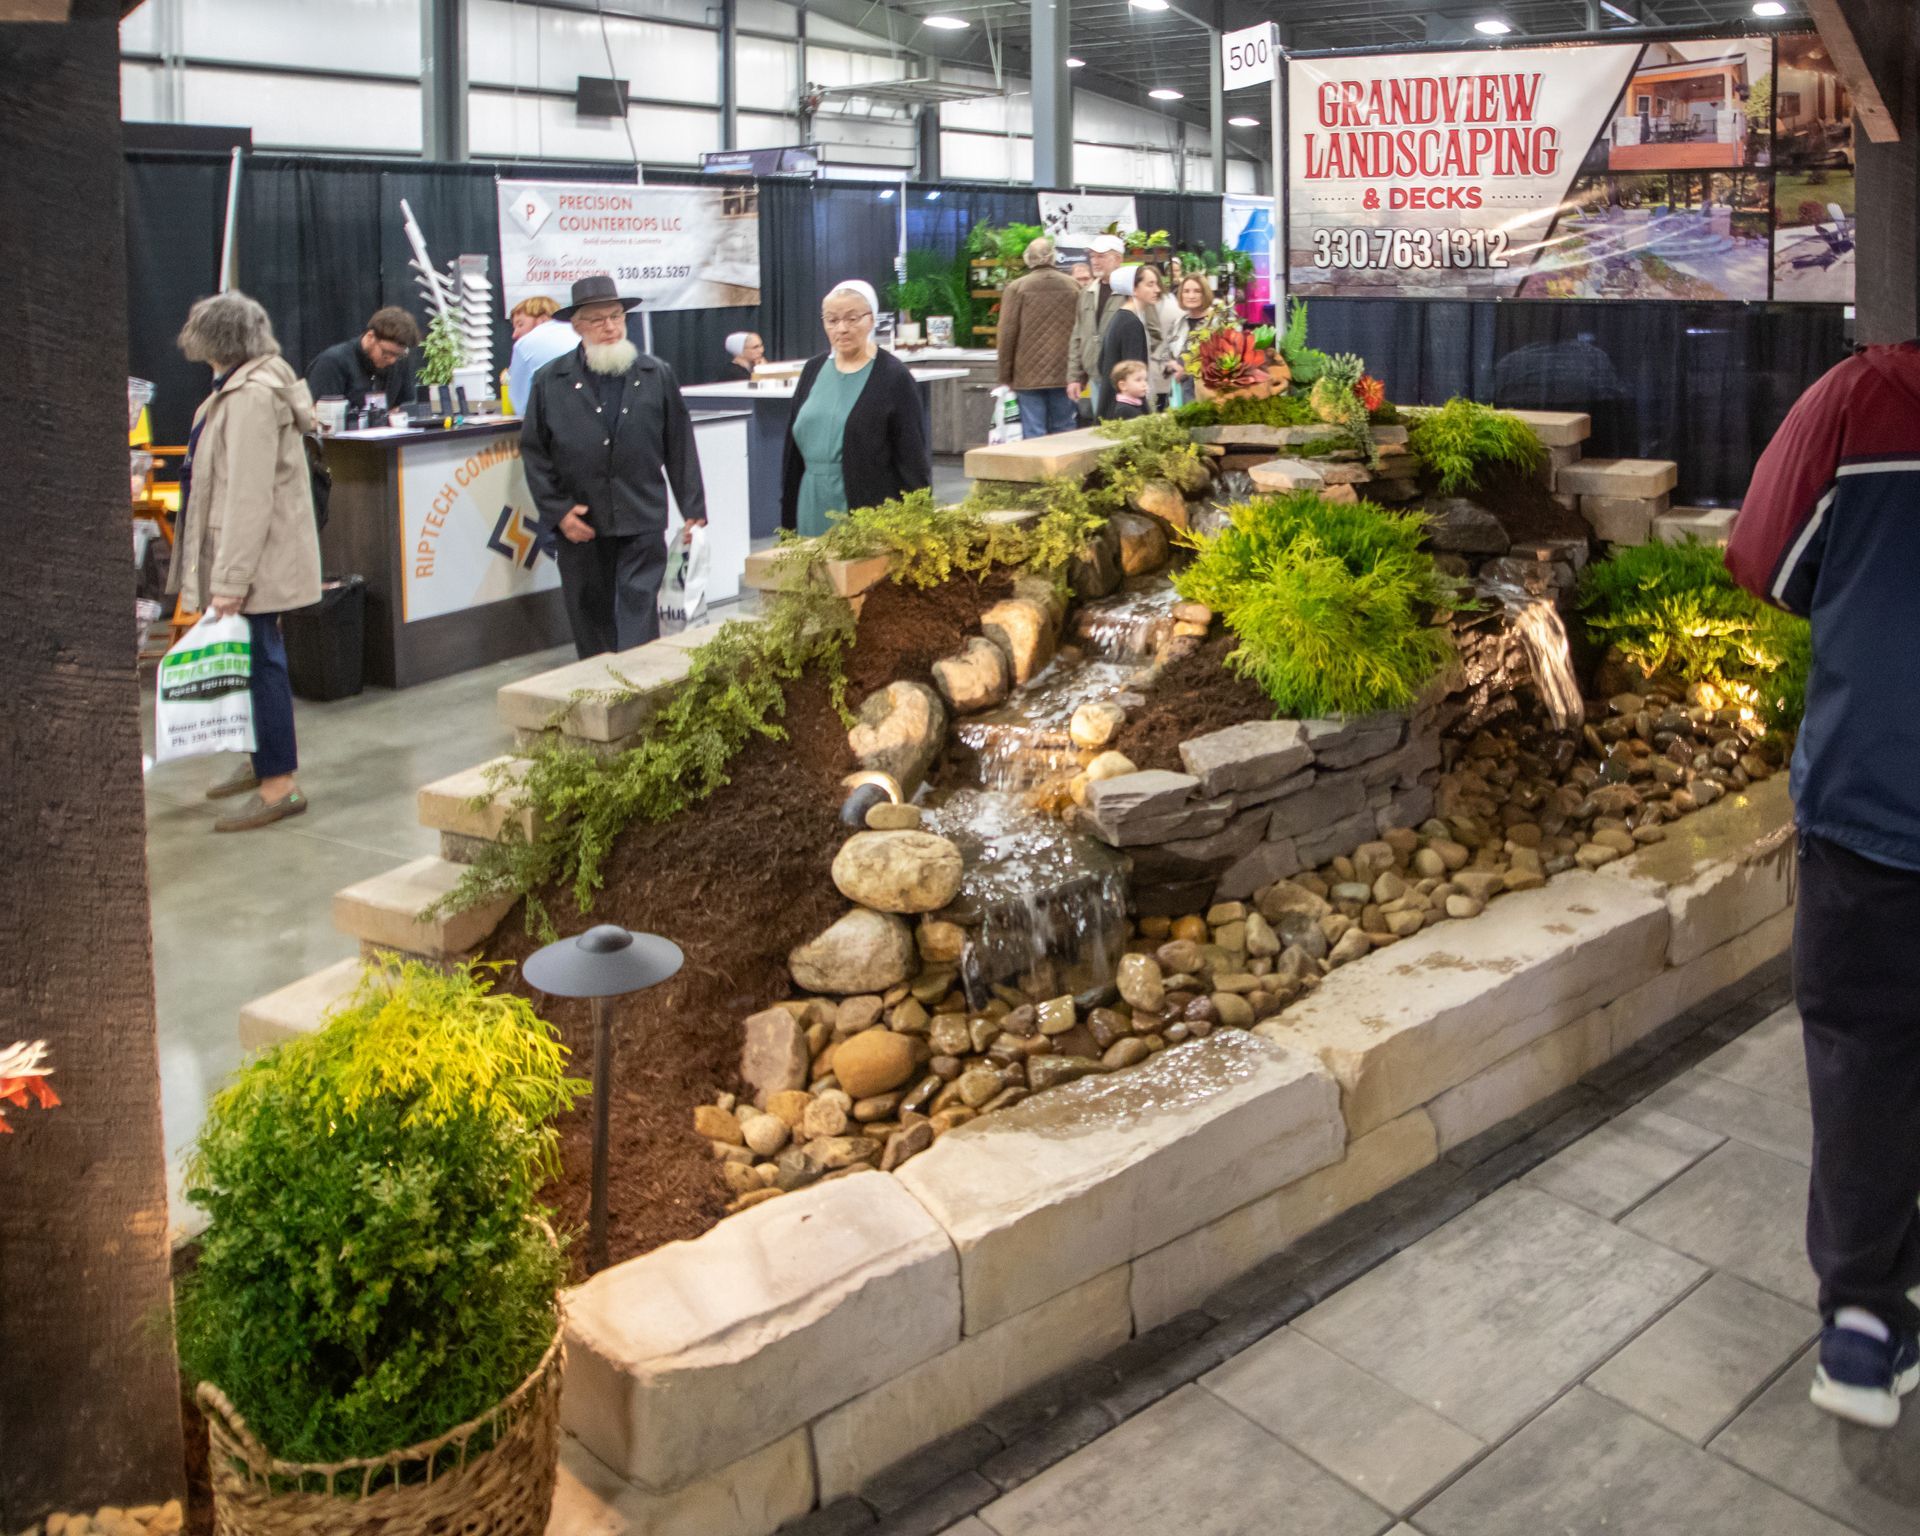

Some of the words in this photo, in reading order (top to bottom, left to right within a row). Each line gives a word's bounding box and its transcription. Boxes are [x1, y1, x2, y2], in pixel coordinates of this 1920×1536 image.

[1230, 36, 1268, 72] 500
[1317, 72, 1543, 127] GRANDVIEW
[1303, 126, 1560, 181] LANDSCAPING
[559, 195, 632, 211] PRECISION
[1362, 188, 1381, 210] &
[1389, 187, 1483, 210] DECKS
[526, 203, 535, 221] P
[559, 216, 658, 232] COUNTERTOPS
[661, 216, 682, 231] LLC
[1313, 228, 1510, 270] 330.763.1312
[526, 271, 550, 282] OUR
[618, 266, 691, 280] 330.852.5267
[415, 483, 459, 579] RIPTECH
[455, 440, 521, 488] COMMU
[659, 605, 687, 621] Hus
